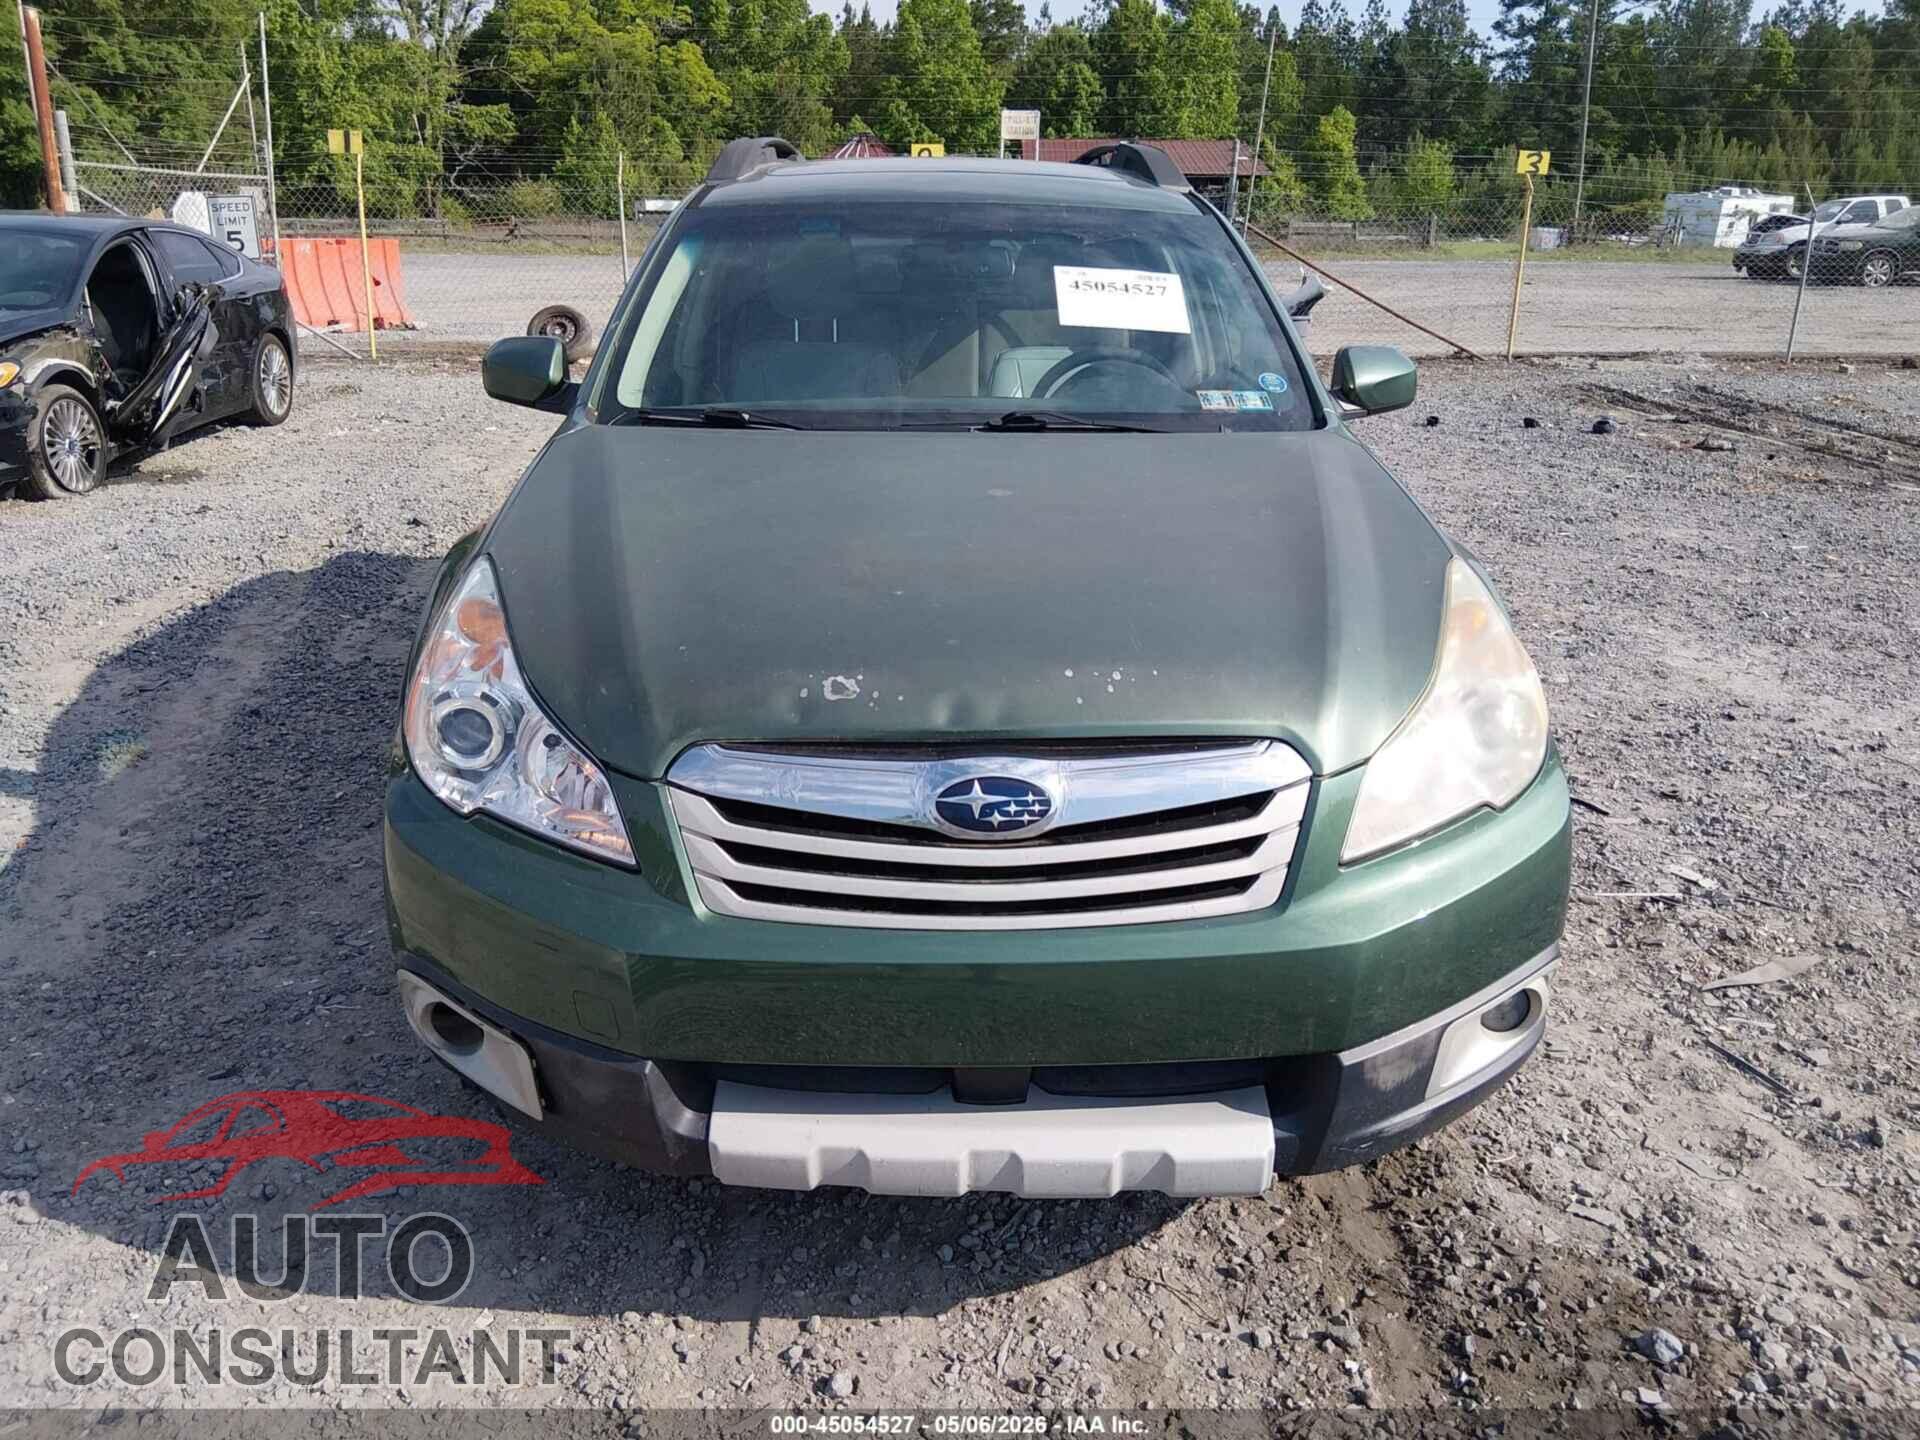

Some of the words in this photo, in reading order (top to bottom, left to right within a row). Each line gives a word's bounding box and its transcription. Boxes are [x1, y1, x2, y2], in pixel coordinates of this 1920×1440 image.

[1525, 151, 1543, 173] 3
[211, 203, 250, 212] SPEED
[217, 216, 247, 226] LIMIT
[227, 231, 245, 252] 5
[1069, 280, 1168, 296] 45054527
